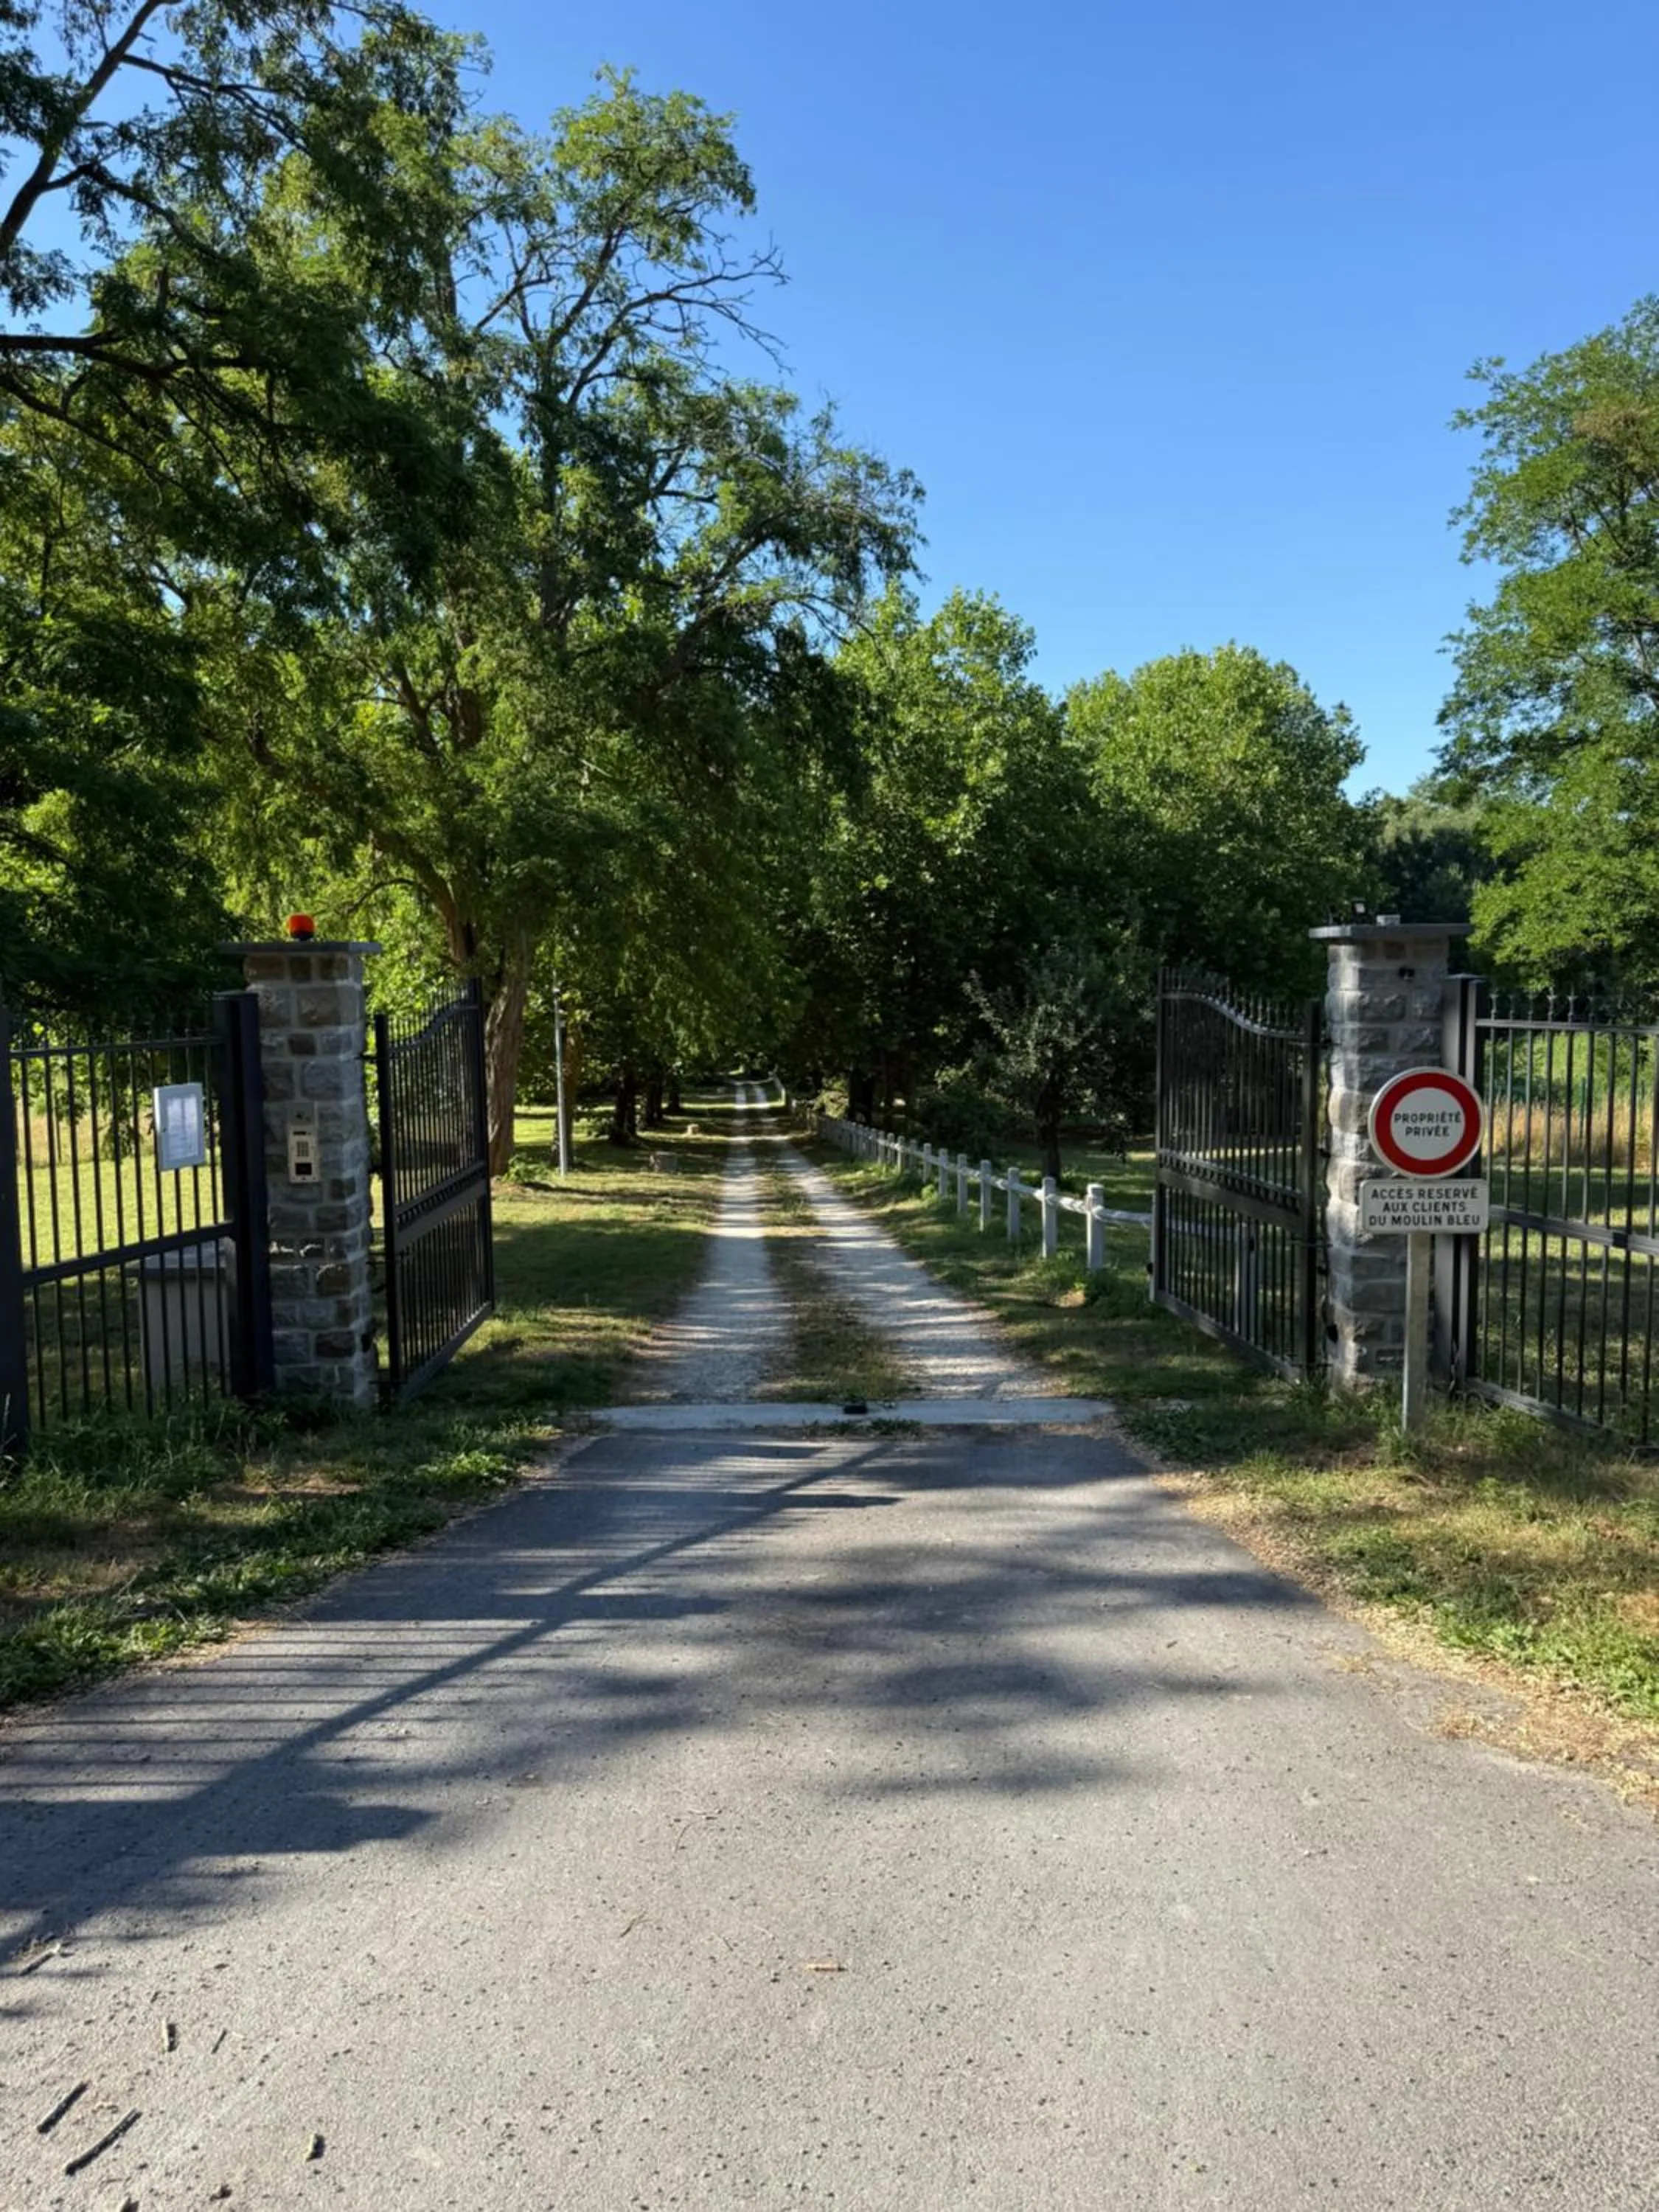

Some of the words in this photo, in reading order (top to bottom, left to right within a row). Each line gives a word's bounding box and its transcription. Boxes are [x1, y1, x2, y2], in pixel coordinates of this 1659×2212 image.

[1394, 1110, 1461, 1123] PROPRIÉTÉ
[1405, 1124, 1450, 1136] PRIVÉE
[1382, 1201, 1408, 1213] AUX
[1413, 1201, 1466, 1213] CLIENTS
[1368, 1214, 1387, 1226] DU
[1391, 1214, 1442, 1226] MOULIN
[1447, 1214, 1480, 1226] BLEU
